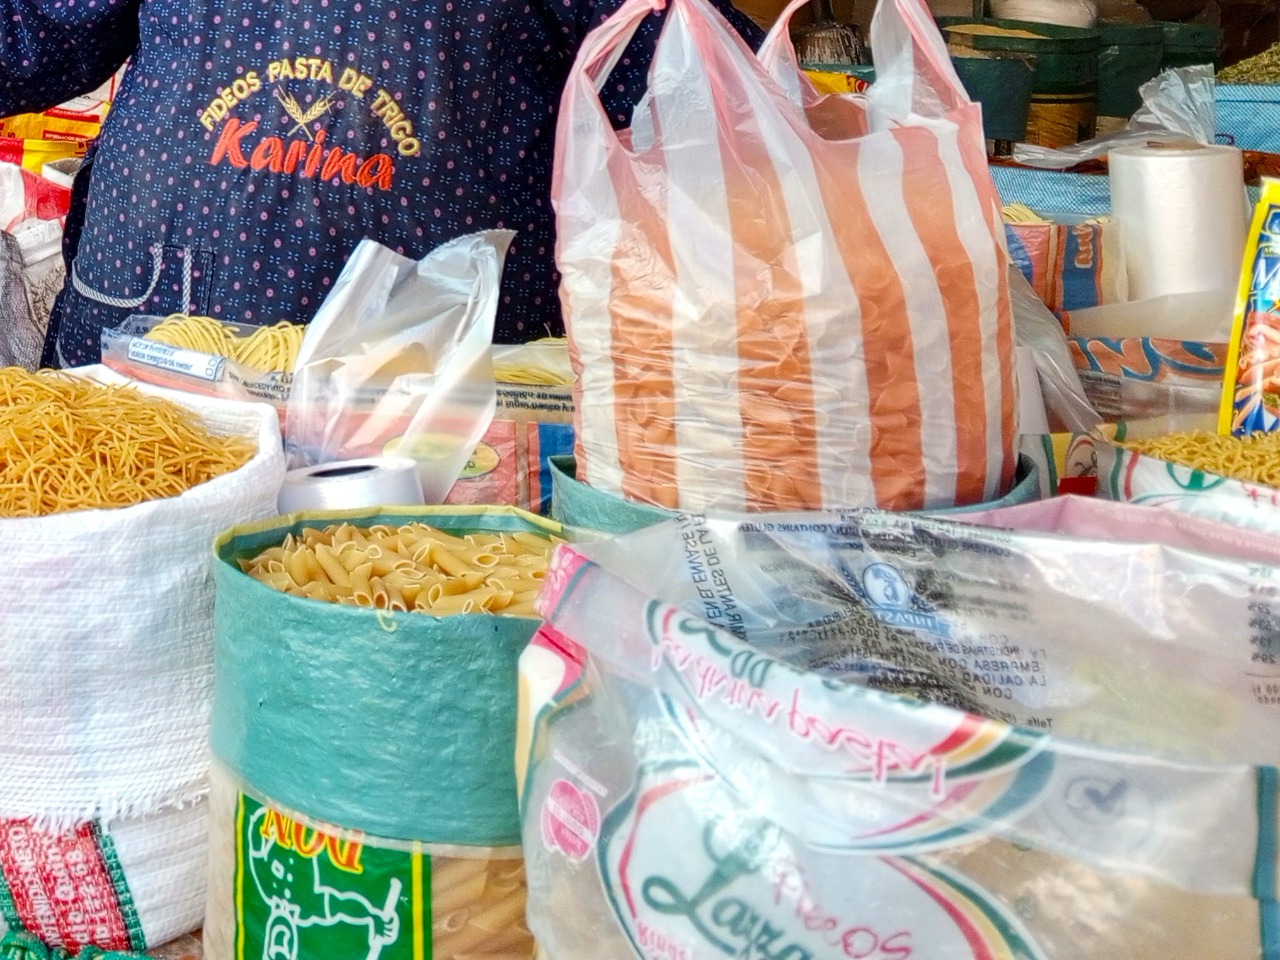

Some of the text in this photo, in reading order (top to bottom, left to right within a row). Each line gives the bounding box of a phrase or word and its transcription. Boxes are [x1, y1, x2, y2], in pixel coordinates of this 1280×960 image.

[198, 57, 421, 157] FIDEOS PASTA DE TRIGO
[209, 117, 393, 191] Karina
